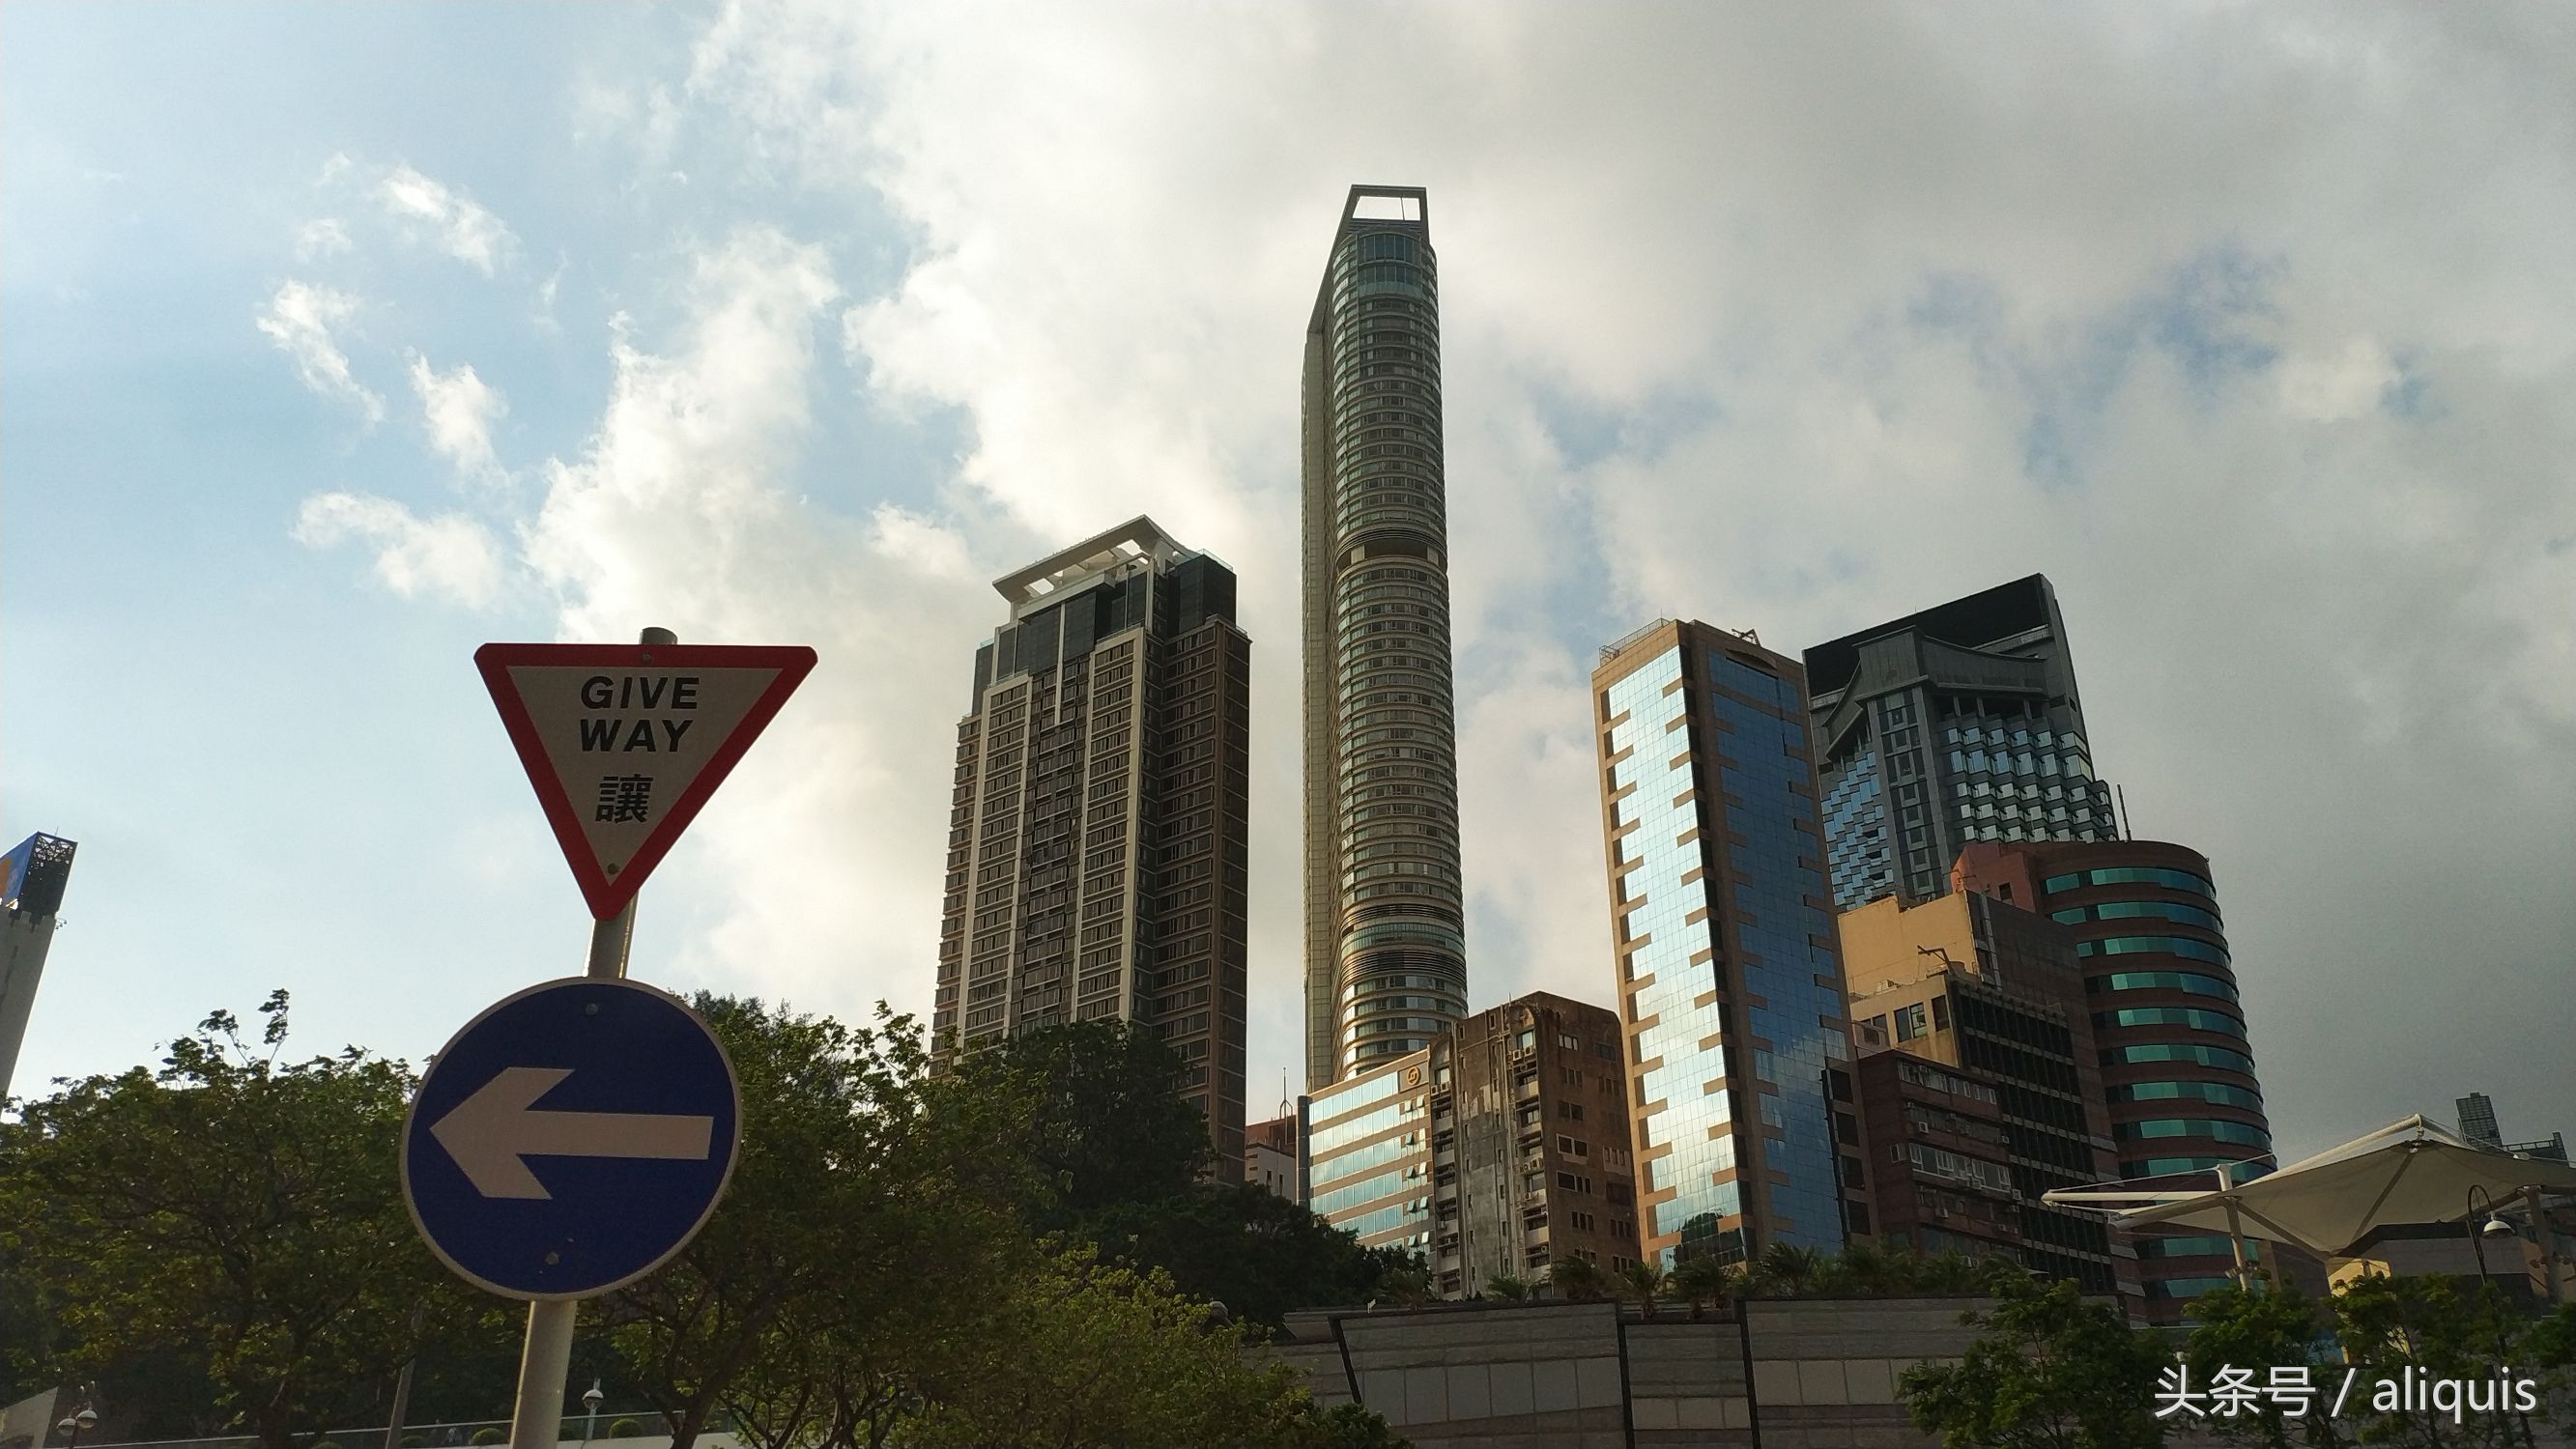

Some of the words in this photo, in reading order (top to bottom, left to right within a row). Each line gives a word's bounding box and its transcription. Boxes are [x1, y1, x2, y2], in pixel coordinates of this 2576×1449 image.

[580, 675, 700, 710] GIVE
[579, 719, 694, 753] WAY
[594, 773, 654, 823] 讓
